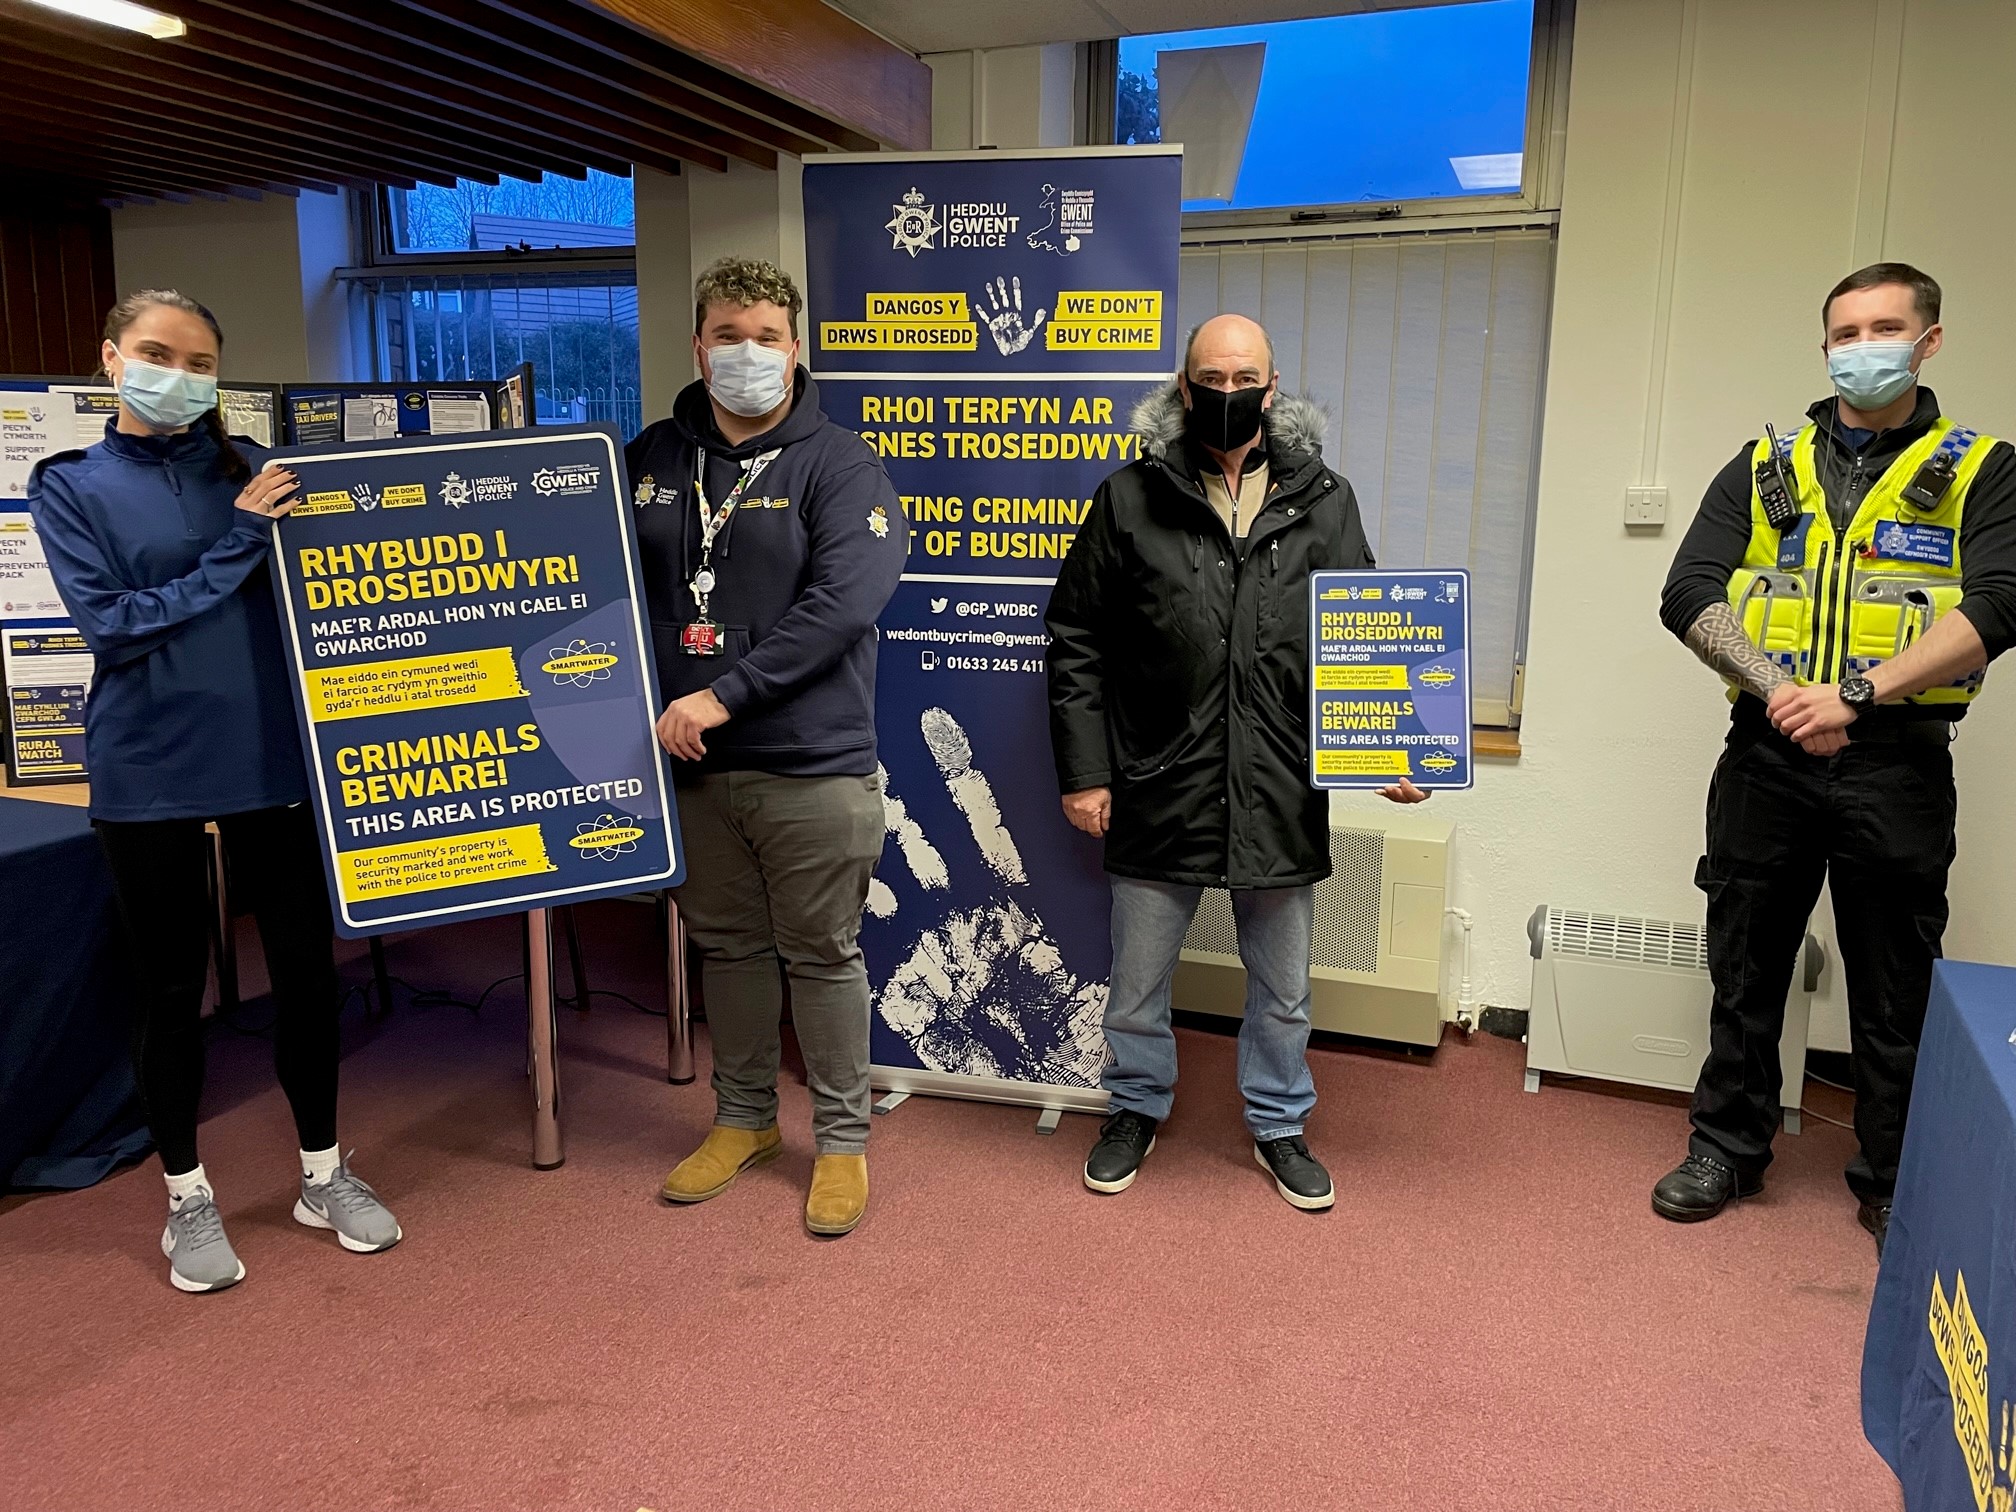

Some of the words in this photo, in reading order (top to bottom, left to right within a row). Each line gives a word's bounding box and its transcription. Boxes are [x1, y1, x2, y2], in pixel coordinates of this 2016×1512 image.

[950, 203, 1006, 216] HEDDLU
[1061, 204, 1093, 220] GWENT
[950, 217, 1019, 234] GWENT
[950, 234, 1006, 248] POLICE
[874, 300, 944, 315] DANGOS
[948, 300, 958, 314] Y
[1066, 299, 1096, 314] WE
[1100, 298, 1155, 314] DON'T
[827, 328, 877, 344] DRWS
[883, 329, 887, 344] I
[894, 328, 972, 344] DROSEDD
[1056, 328, 1091, 343] BUY
[1097, 328, 1154, 343] CRIME
[862, 396, 933, 423] RHOI
[944, 397, 1060, 424] TERFYN
[1068, 398, 1112, 424] AR
[295, 416, 309, 424] TAXI
[310, 413, 337, 422] DRIVERS
[860, 431, 936, 458] SNES
[749, 460, 767, 480] LICE
[476, 476, 510, 485] HEDDLU
[476, 482, 518, 494] GWENT
[538, 472, 600, 490] GWENT
[310, 494, 338, 502] DANGOS
[478, 492, 512, 502] POLICE
[320, 503, 353, 512] DROSEDD
[898, 496, 963, 522] TING
[1916, 528, 1945, 537] COMMUNITY
[926, 530, 962, 556] OF
[970, 532, 1076, 559] BUSINE
[299, 532, 483, 578] RHYBUDD
[494, 530, 508, 558] I
[1781, 553, 1796, 562] 404
[304, 554, 580, 611] DROSEDDWYR!
[311, 617, 372, 638] MAE'R
[377, 610, 441, 632] ARDAL
[446, 606, 484, 623] HON
[488, 602, 516, 618] YN
[520, 596, 563, 615] CAEL
[566, 593, 588, 610] EI
[956, 602, 1038, 618] @GP_WDBC
[1321, 612, 1402, 626] RHYBUDD
[1406, 612, 1412, 626] I
[314, 630, 428, 658] GWARCHOD
[886, 628, 1053, 647] wedontbuycrime@gwent.
[1321, 644, 1347, 653] MAE'R
[1349, 644, 1377, 653] ARDAL
[1379, 644, 1397, 653] HON
[1399, 644, 1412, 653] YN
[1414, 644, 1434, 653] CAEL
[550, 656, 610, 671] SMARTWATER
[947, 656, 988, 670] 01633
[992, 658, 1018, 672] 245
[1022, 660, 1044, 672] 411
[1321, 653, 1370, 662] GWARCHOD
[321, 676, 344, 687] Mae
[348, 672, 378, 684] eiddo
[381, 670, 398, 680] ein
[401, 664, 450, 680] cymuned
[453, 659, 478, 670] wedi
[323, 688, 334, 699] ei
[336, 684, 368, 698] farcio
[372, 684, 384, 692] ac
[387, 679, 422, 693] rydym
[425, 678, 438, 689] yn
[442, 671, 487, 686] gweithio
[325, 698, 360, 712] gyda'r
[364, 692, 402, 708] heddlu
[404, 691, 408, 702] i
[411, 689, 432, 700] atal
[434, 684, 476, 698] trosedd
[1321, 701, 1414, 716] CRIMINALS
[18, 740, 60, 750] RURAL
[1321, 735, 1347, 745] THIS
[1350, 735, 1379, 745] AREA
[1382, 735, 1393, 745] IS
[1396, 735, 1459, 745] PROTECTED
[18, 749, 62, 759] WATCH
[335, 723, 540, 775] CRIMINALS
[341, 759, 508, 807] BEWARE!
[346, 813, 404, 838] THIS
[411, 804, 476, 829] AREA
[480, 798, 505, 818] IS
[511, 778, 643, 814] PROTECTED
[577, 831, 636, 845] SMARTWATER
[353, 858, 373, 868] Our
[377, 846, 446, 864] community's
[450, 840, 495, 855] property
[498, 838, 508, 846] is
[356, 866, 400, 880] security
[403, 858, 444, 873] marked
[447, 854, 467, 866] and
[470, 853, 484, 862] we
[487, 848, 514, 860] work
[358, 879, 382, 891] with
[385, 876, 402, 887] the
[406, 872, 437, 886] police
[440, 870, 450, 878] to
[454, 863, 494, 878] prevent
[497, 858, 527, 870] crime
[1933, 1292, 1955, 1366] DRWS
